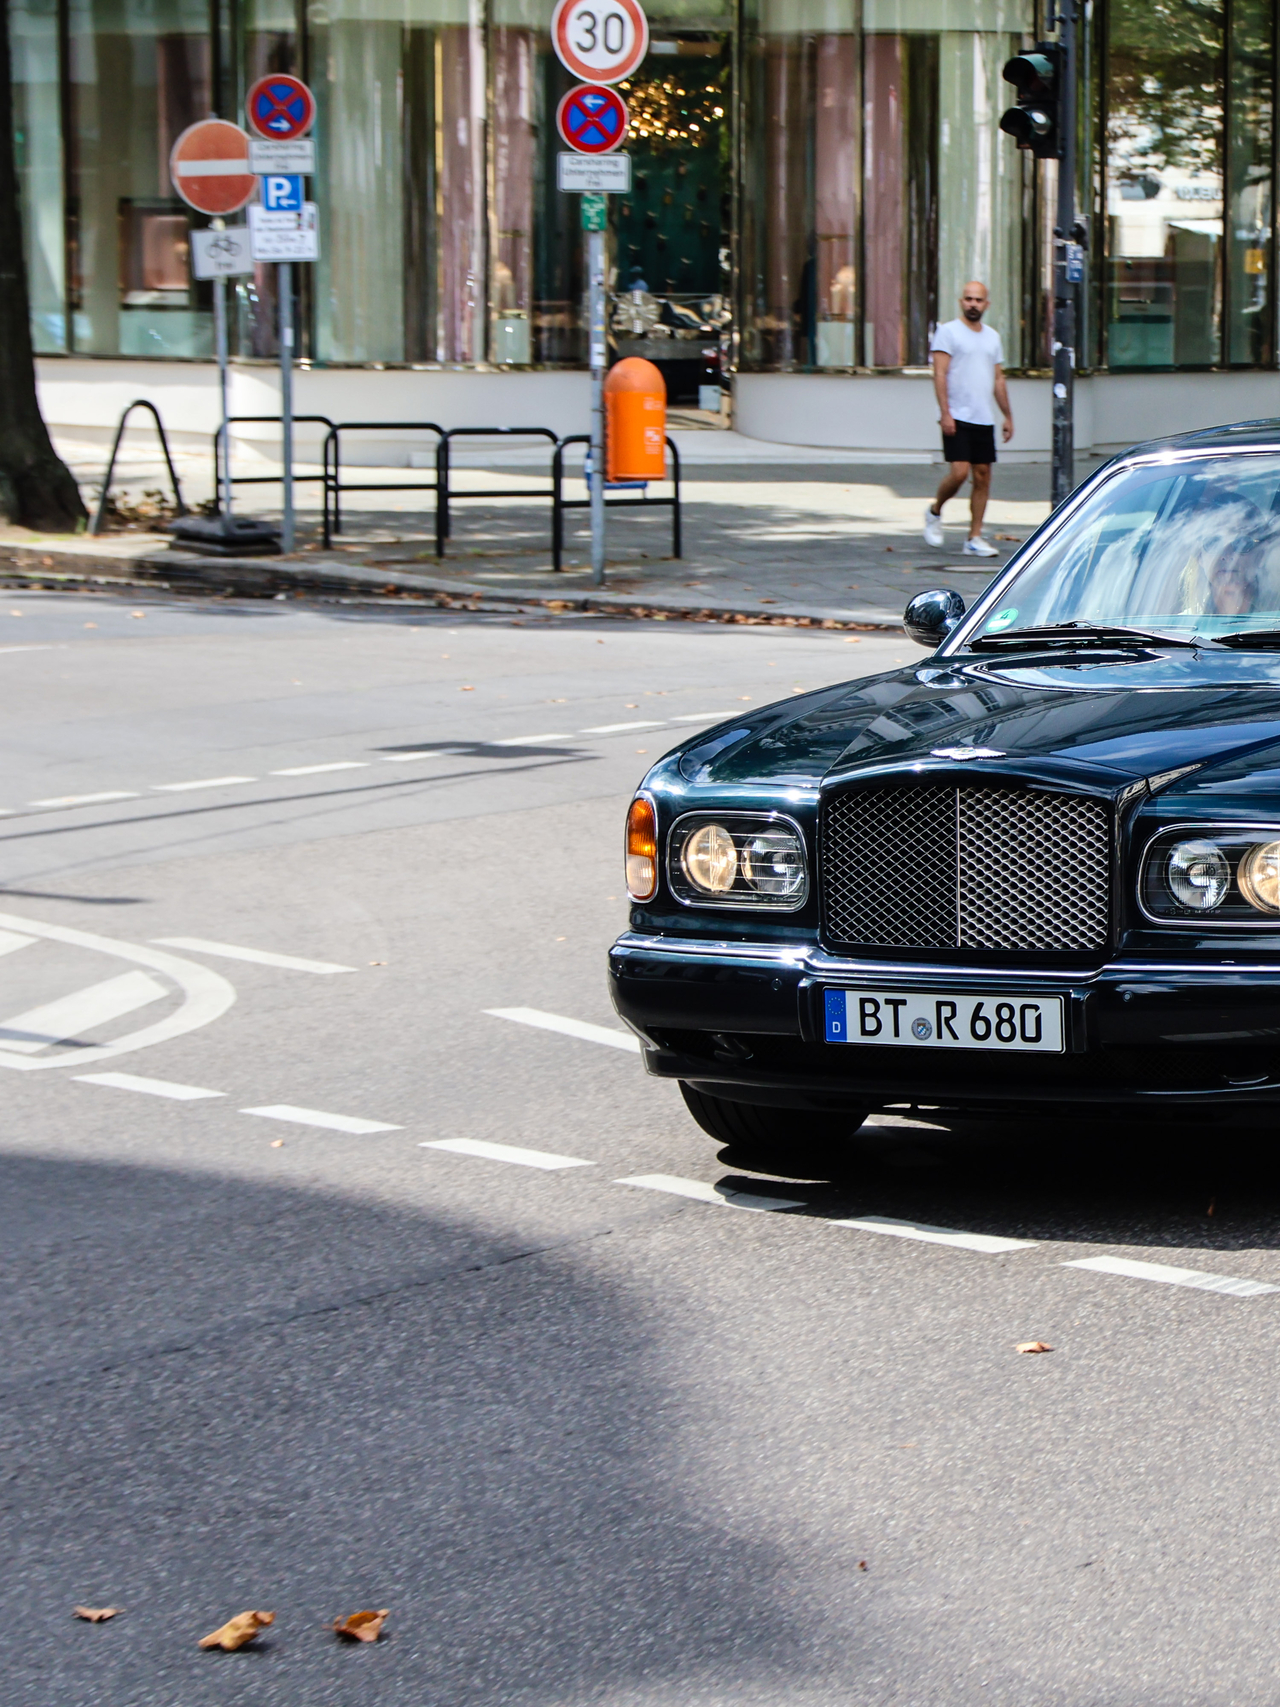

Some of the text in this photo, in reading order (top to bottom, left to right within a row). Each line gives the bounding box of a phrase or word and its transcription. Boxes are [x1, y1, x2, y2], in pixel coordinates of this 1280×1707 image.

[575, 11, 624, 54] 30
[267, 177, 292, 208] P
[832, 1021, 841, 1033] D
[858, 997, 1042, 1043] BT R 680
